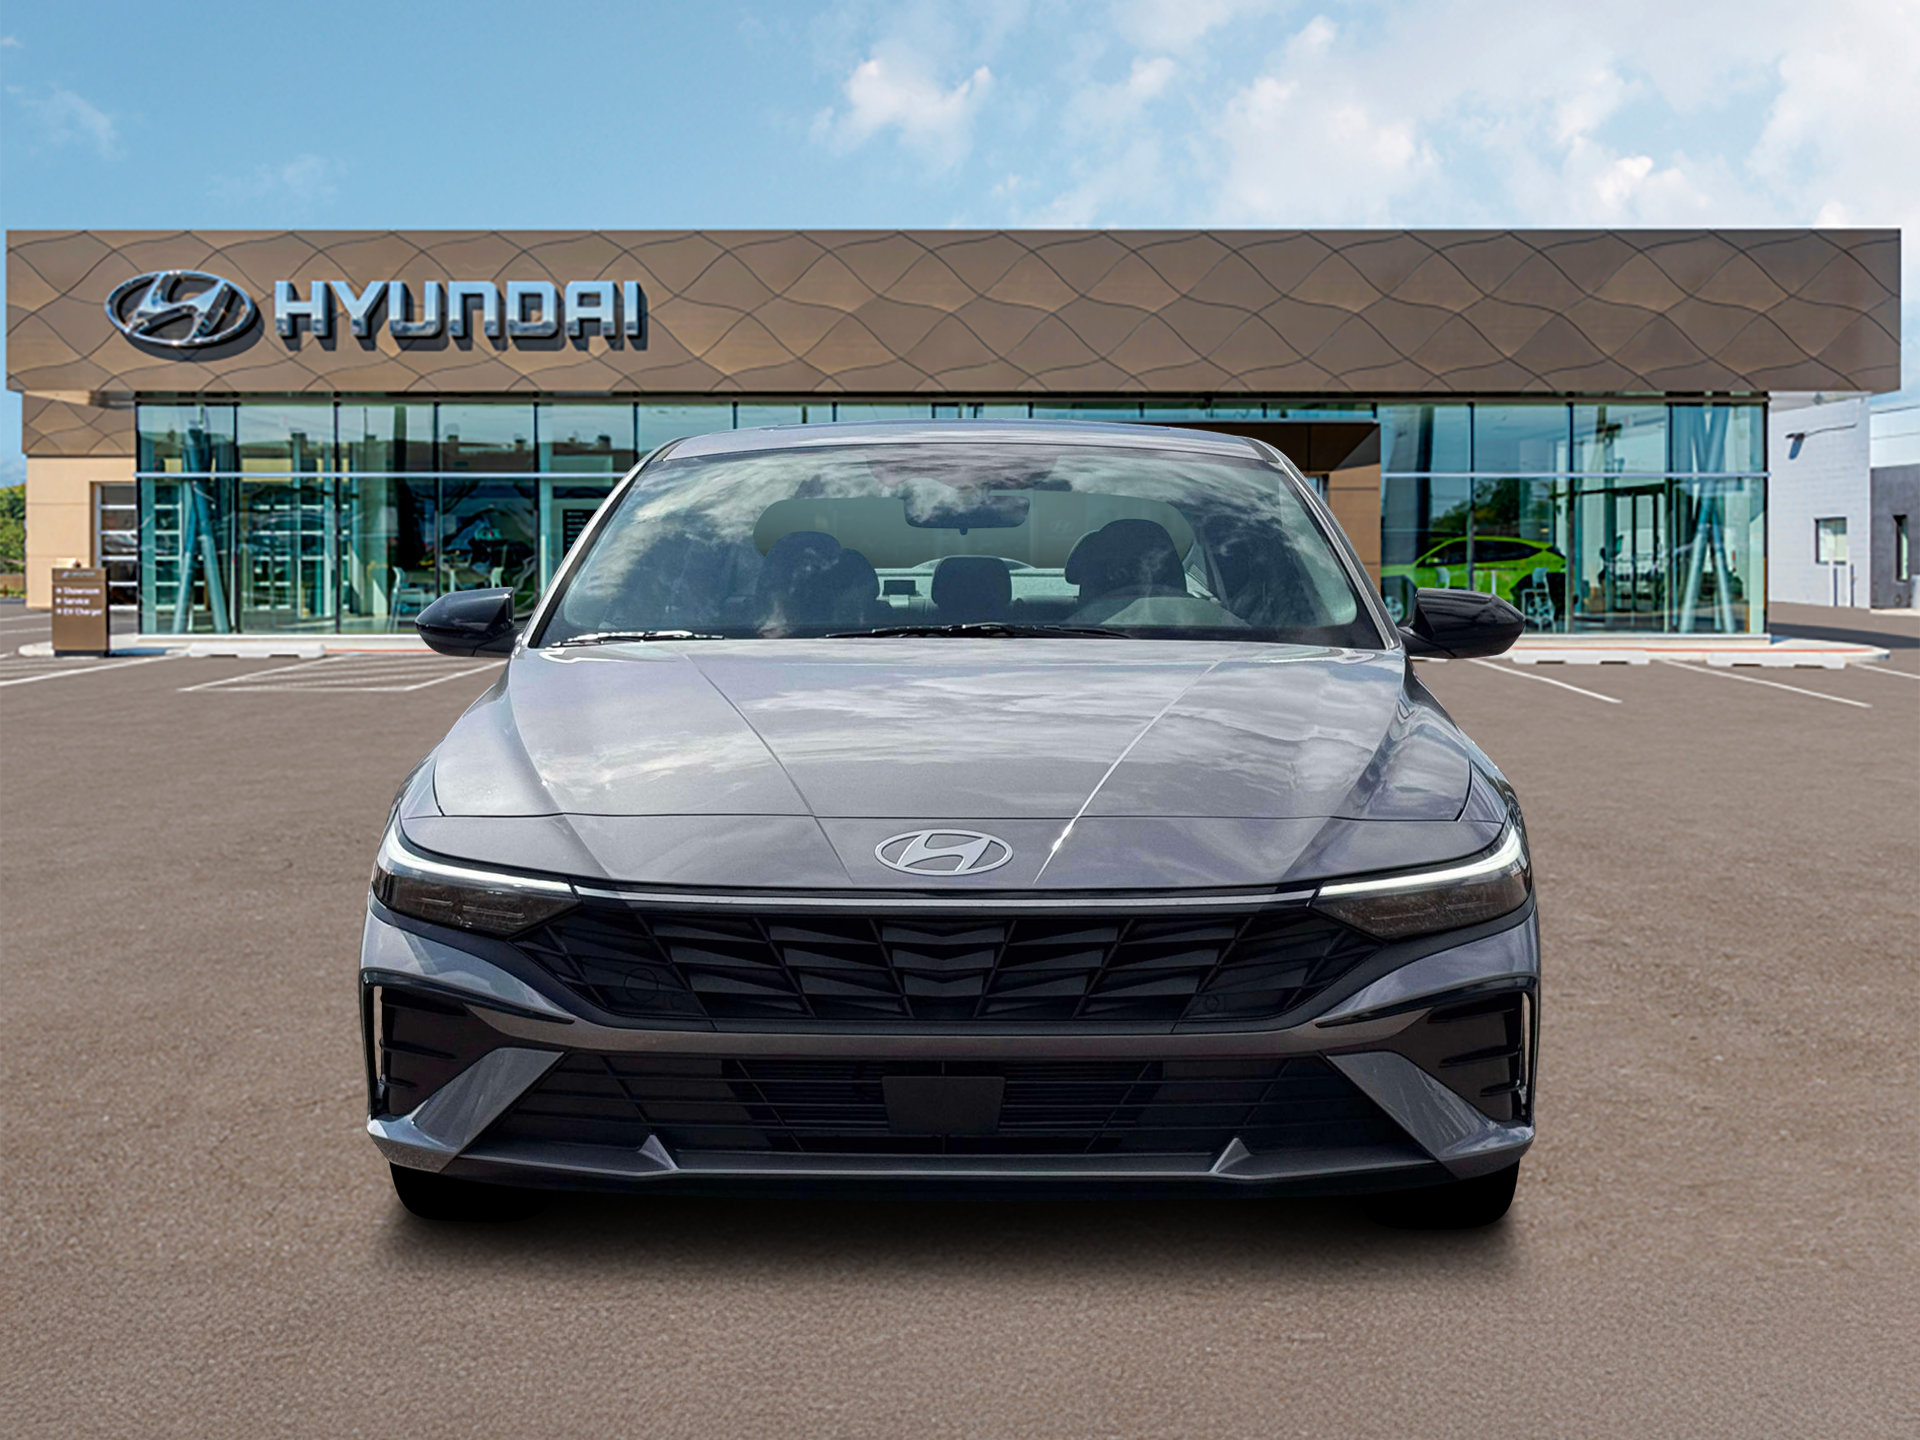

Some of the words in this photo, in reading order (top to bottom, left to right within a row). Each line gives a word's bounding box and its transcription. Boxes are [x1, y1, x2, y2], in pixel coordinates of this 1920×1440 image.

[274, 280, 642, 339] HYUNDAI
[63, 587, 100, 595] Showroom
[63, 597, 90, 606] Service
